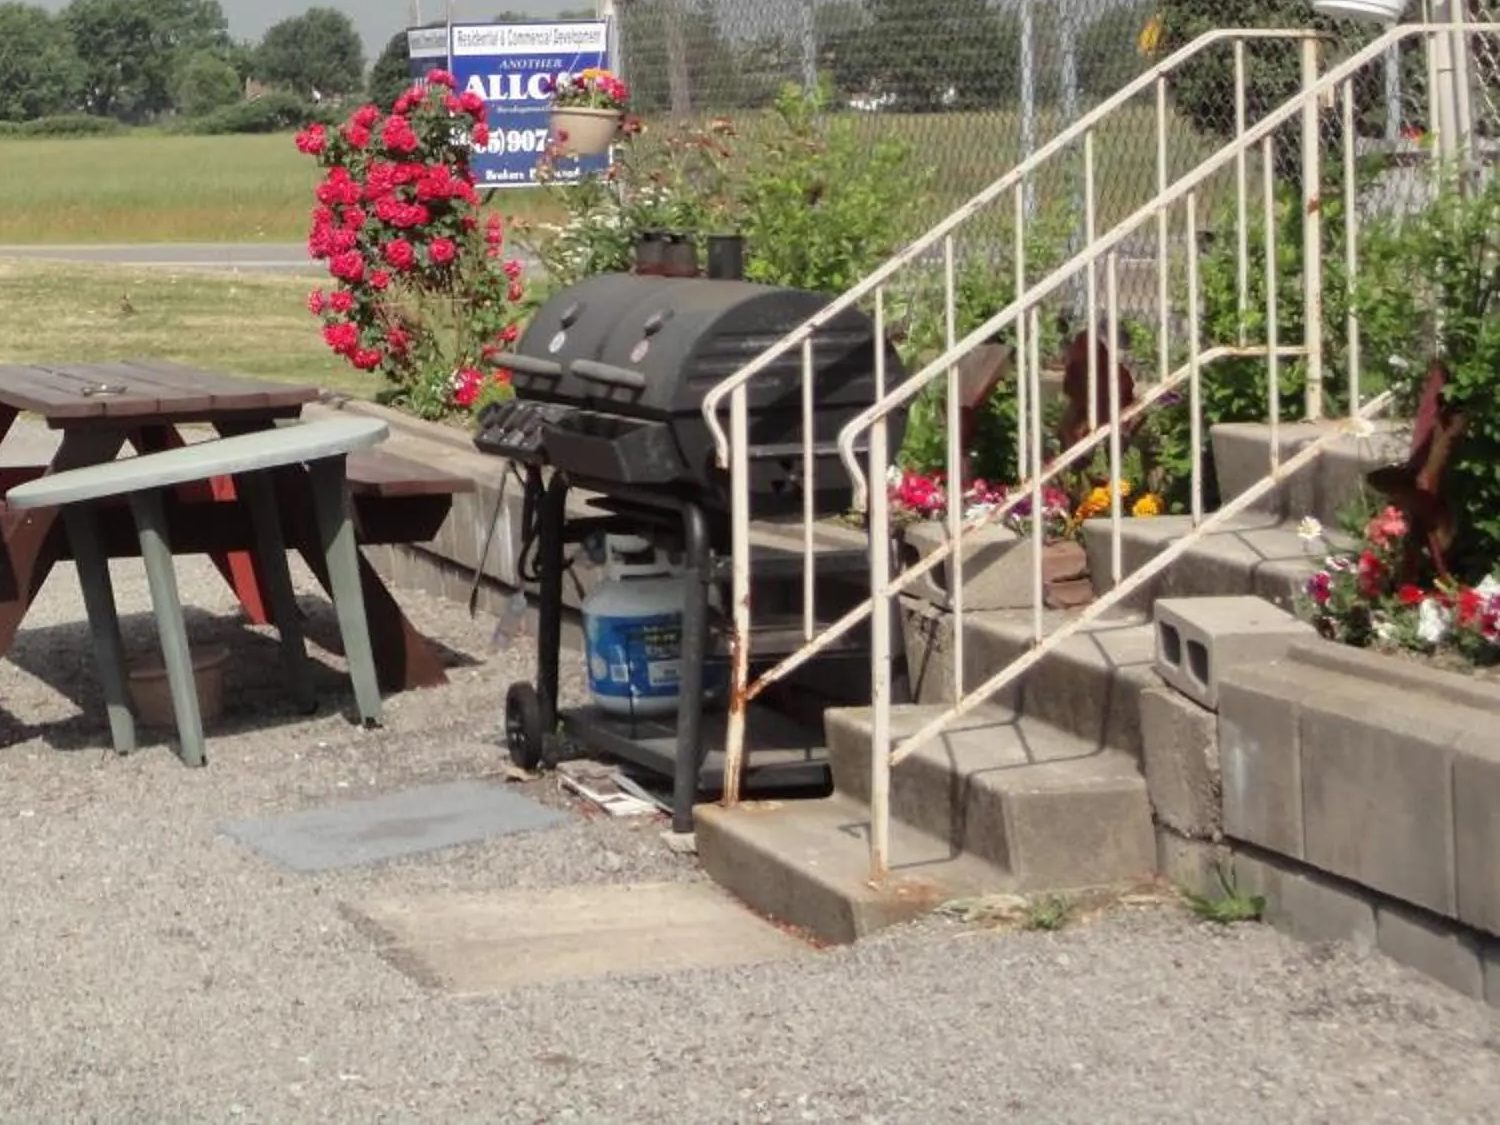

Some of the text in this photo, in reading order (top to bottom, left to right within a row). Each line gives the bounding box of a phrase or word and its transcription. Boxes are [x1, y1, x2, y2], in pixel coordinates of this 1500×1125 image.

[457, 29, 498, 48] Residential
[508, 28, 553, 46] Commercial
[553, 27, 600, 46] Development
[499, 58, 562, 70] ANOTHER
